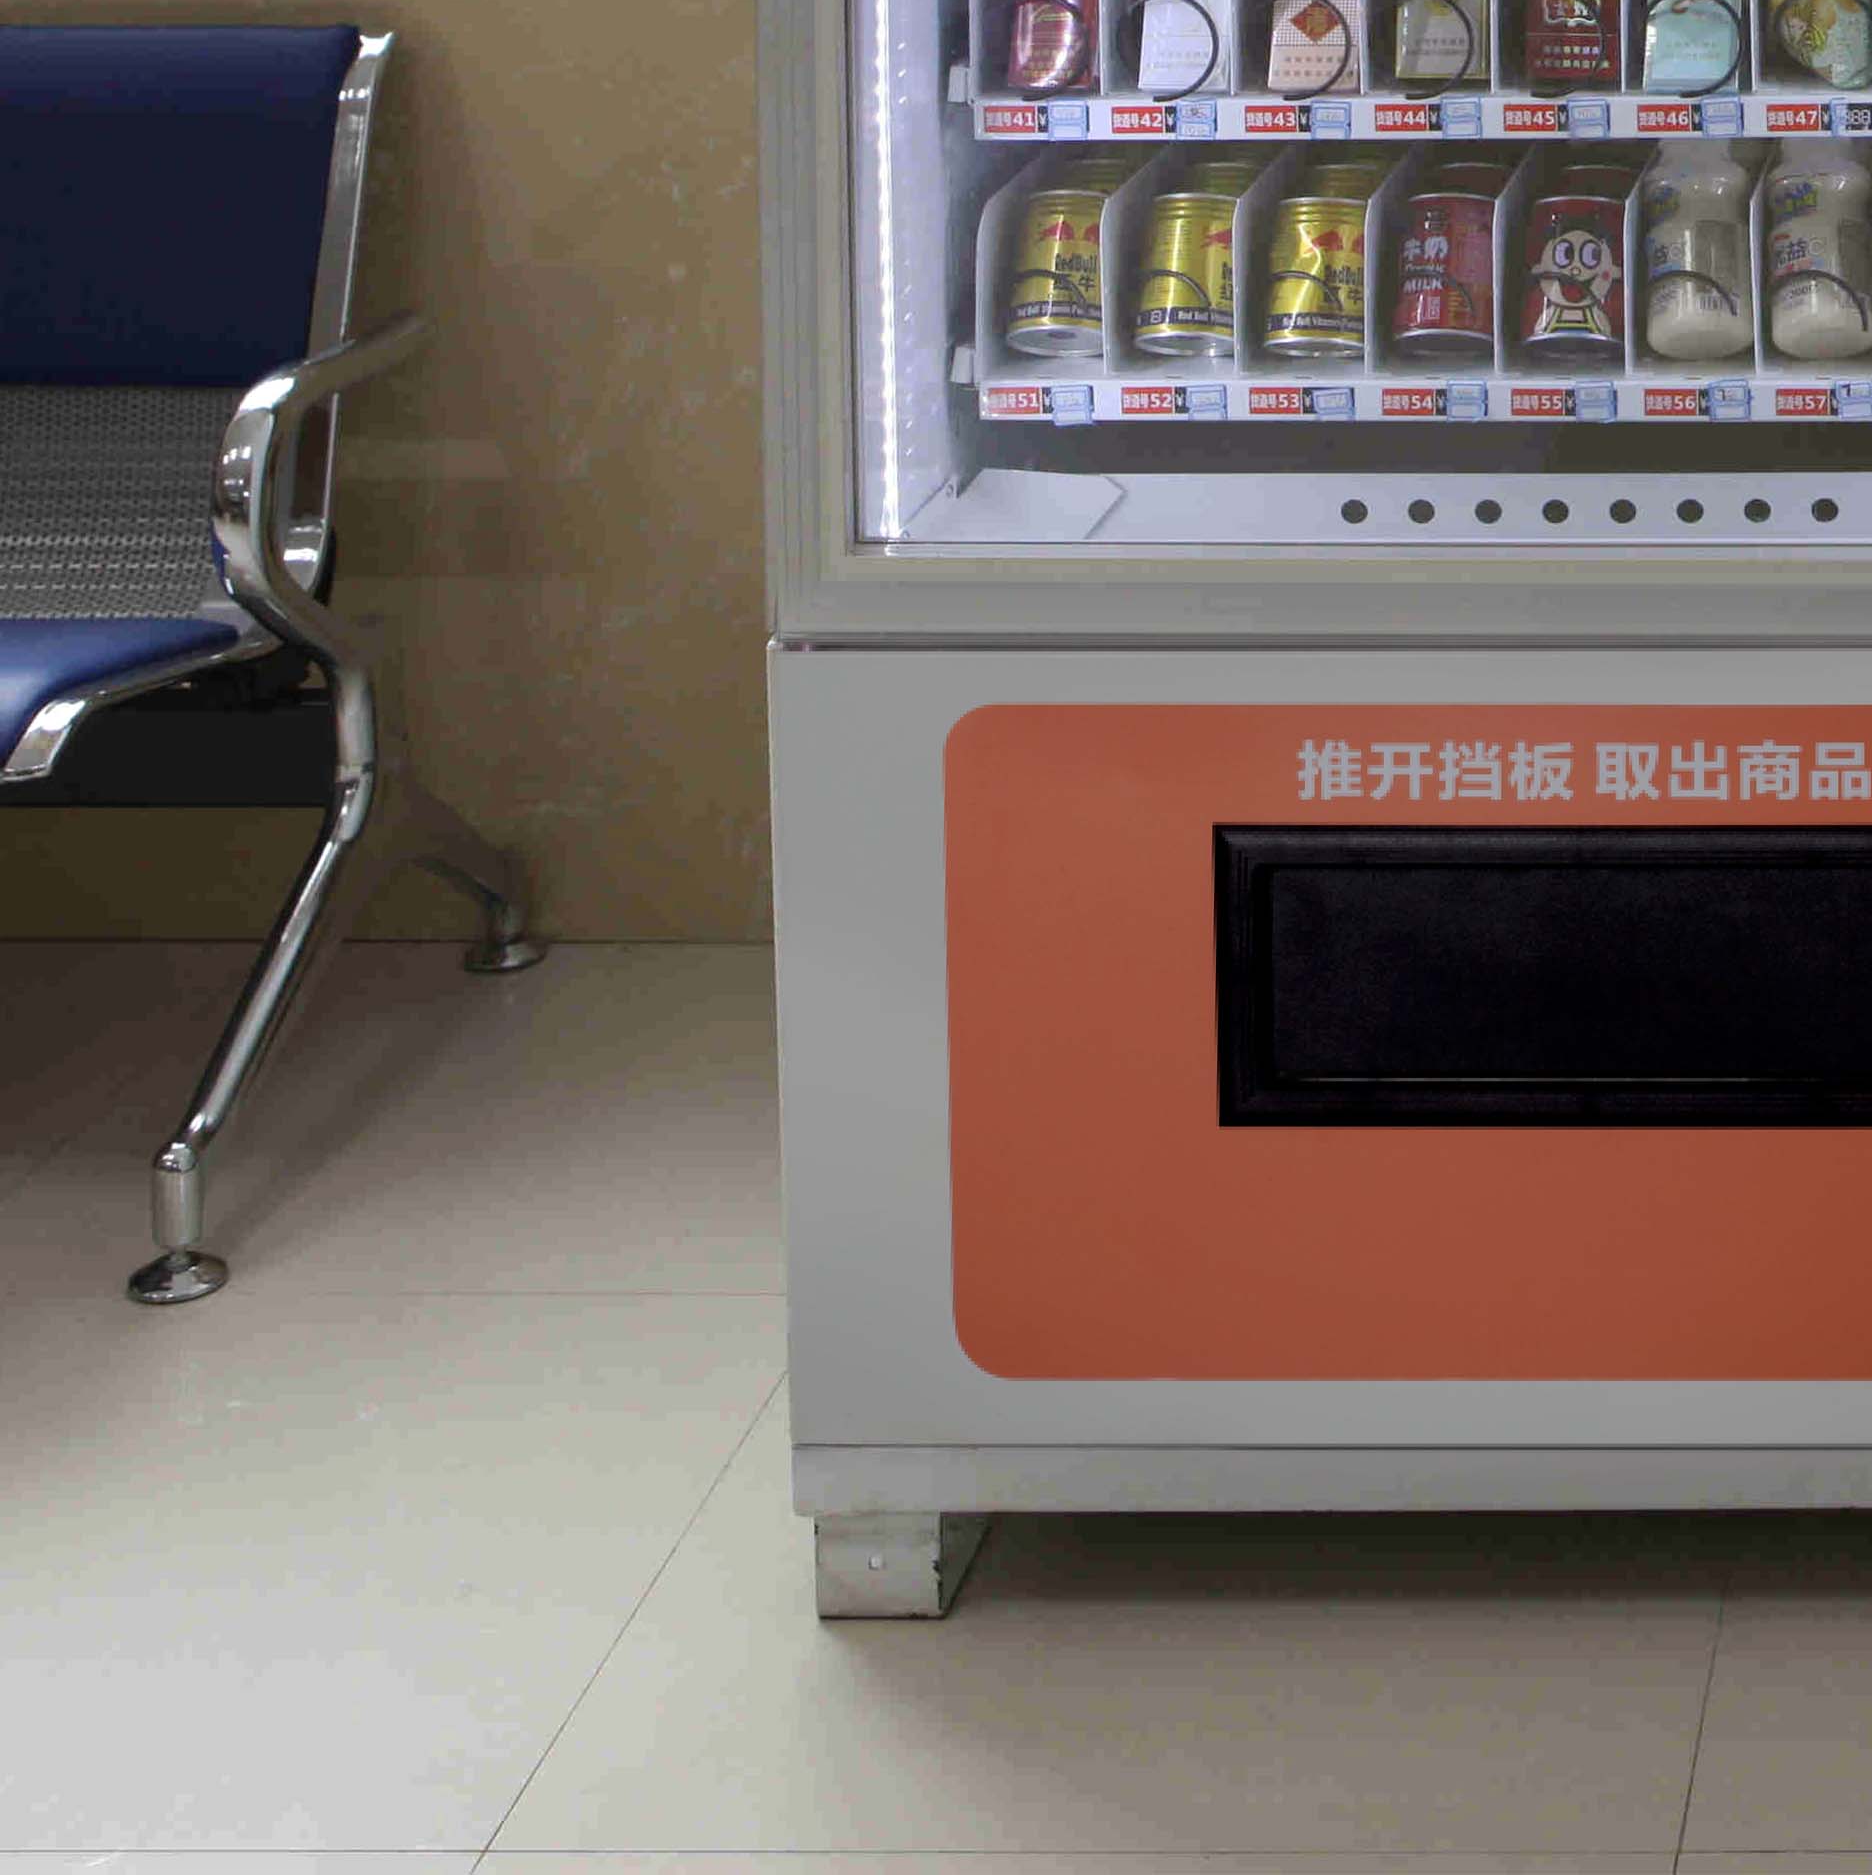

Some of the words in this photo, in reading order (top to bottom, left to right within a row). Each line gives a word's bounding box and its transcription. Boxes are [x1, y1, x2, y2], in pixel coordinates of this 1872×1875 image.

[1298, 739, 1575, 801] 推开挡板
[1594, 739, 1872, 801] 取出商品
